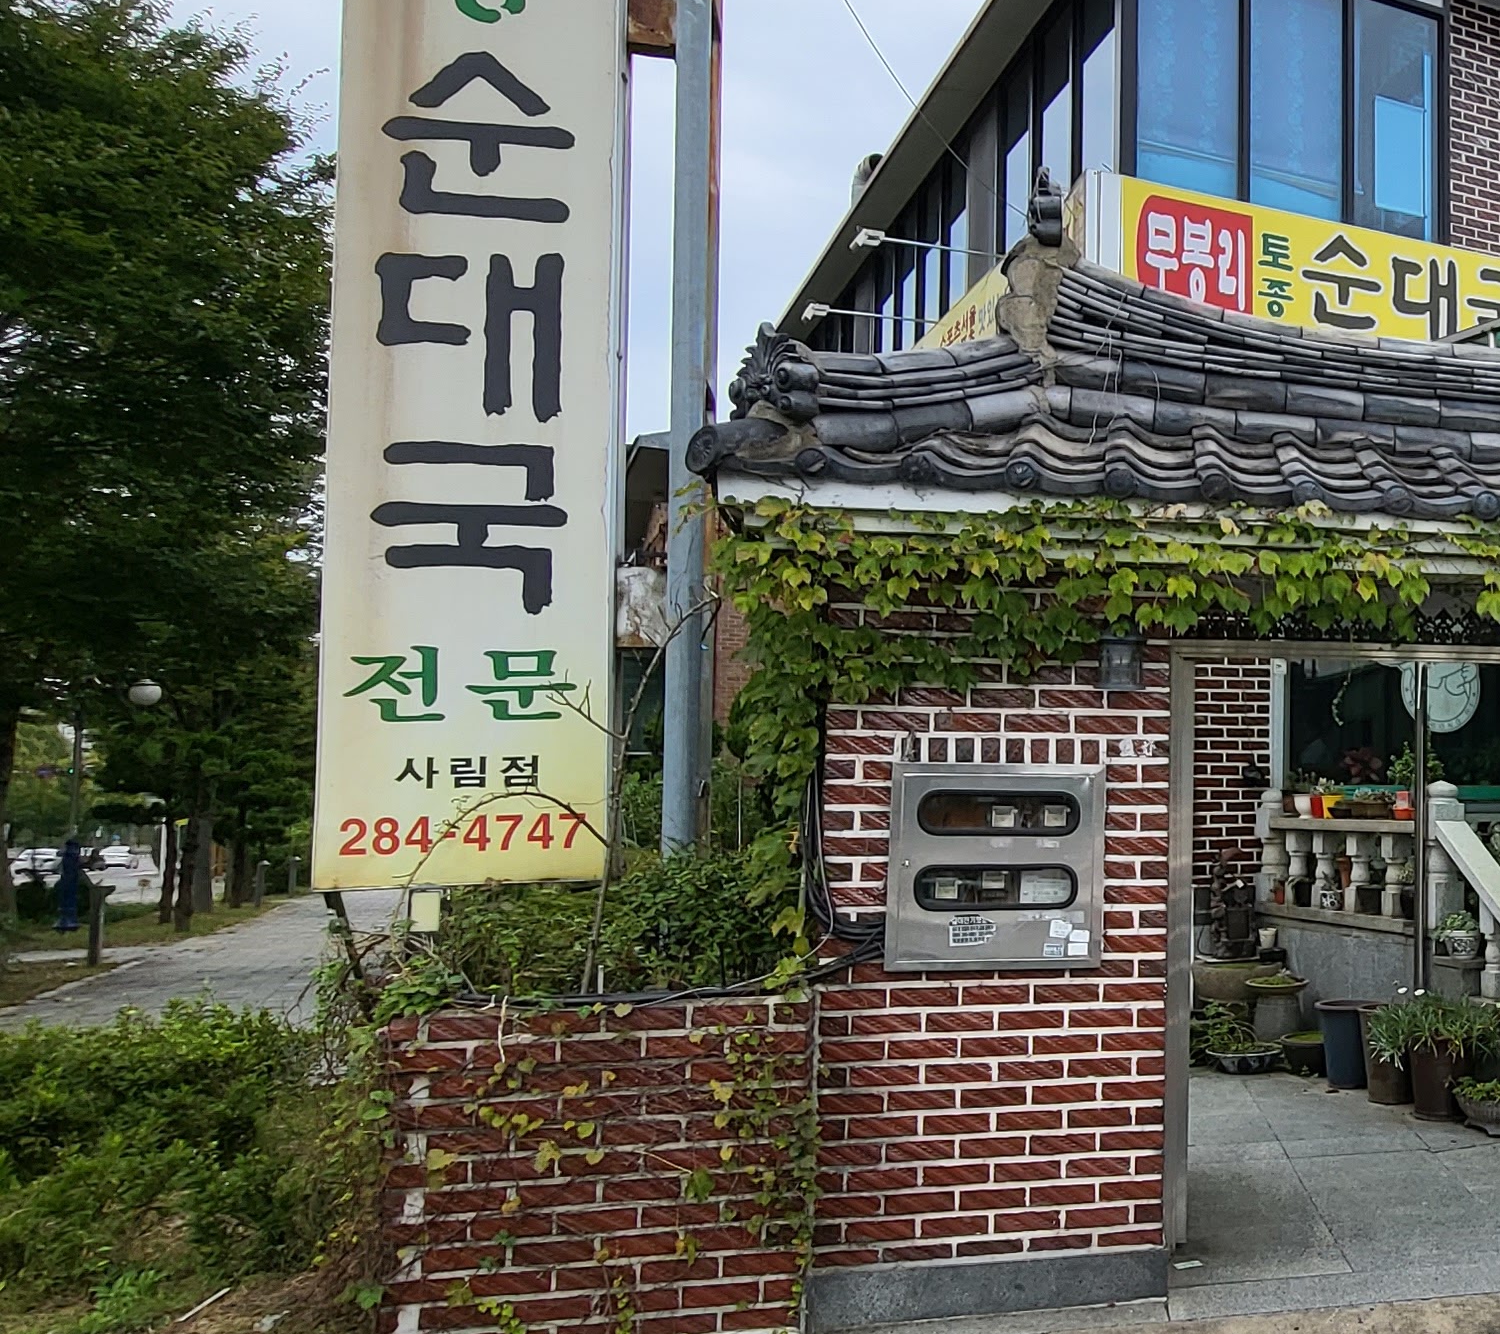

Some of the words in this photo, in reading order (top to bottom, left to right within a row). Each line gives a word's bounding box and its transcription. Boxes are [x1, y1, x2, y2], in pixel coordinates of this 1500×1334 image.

[1145, 211, 1245, 311] 무봉리
[1257, 232, 1295, 318] 토종
[394, 754, 540, 789] 사림점
[338, 812, 587, 858] 284-4747
